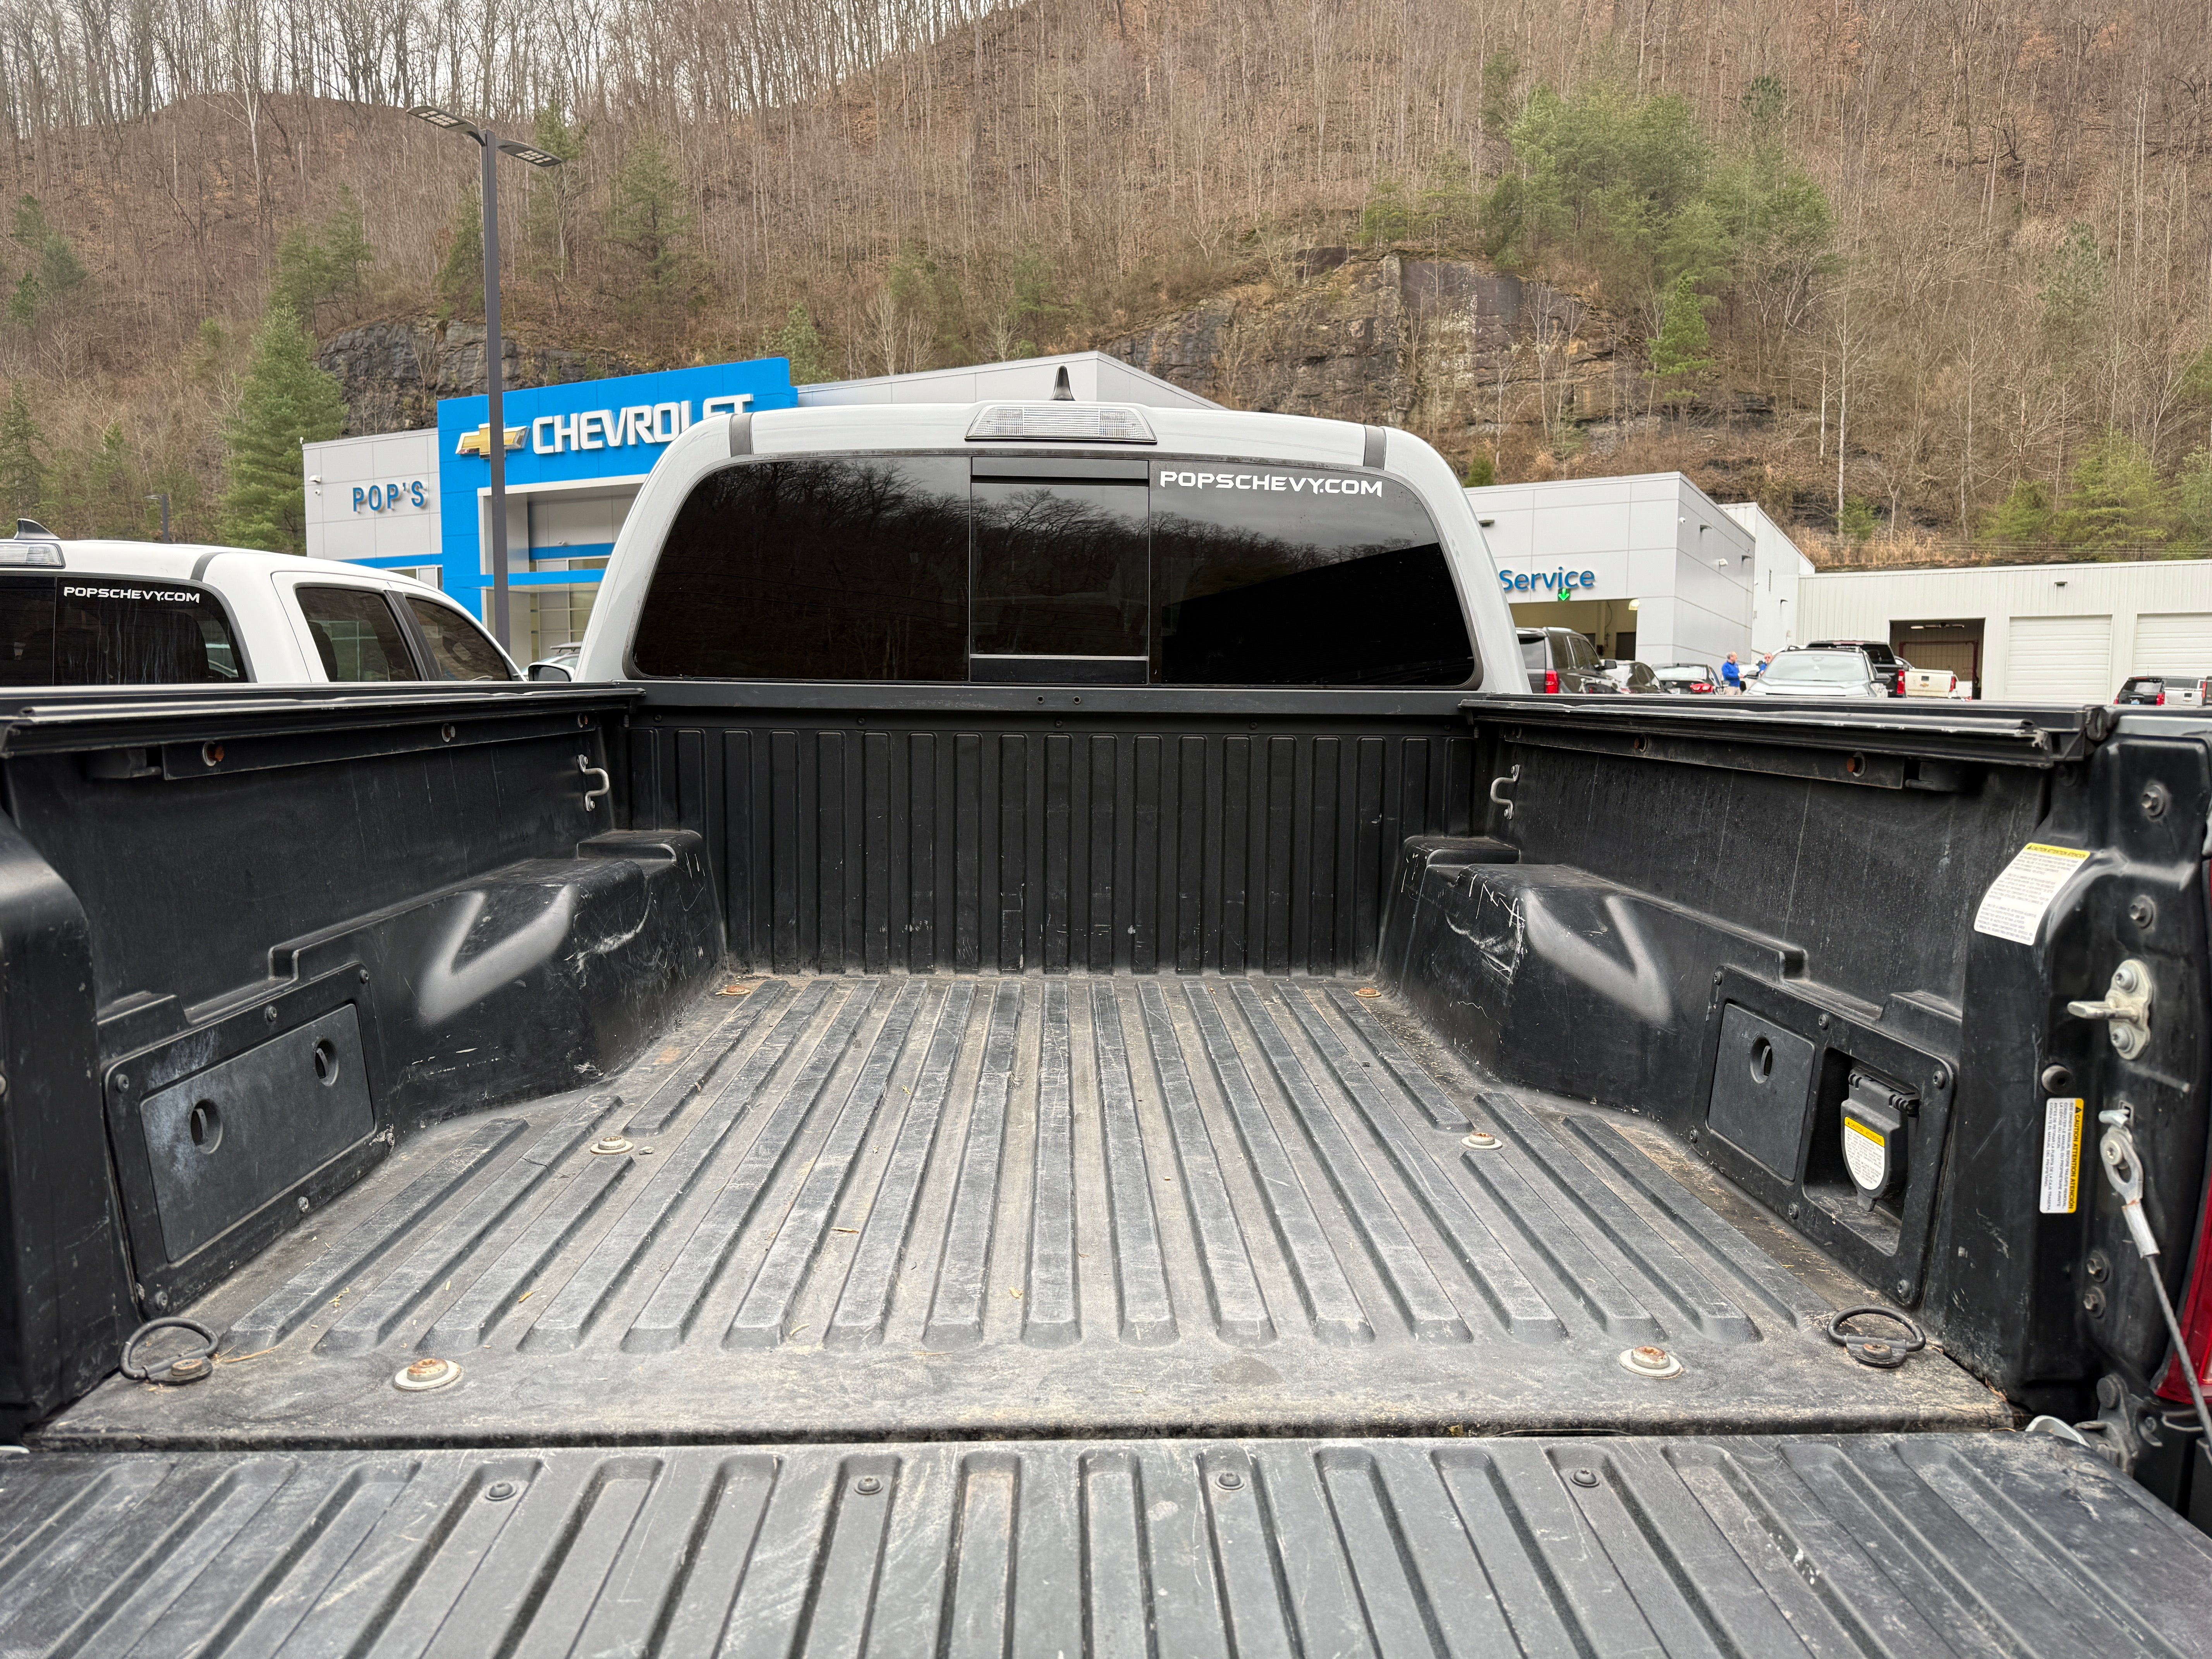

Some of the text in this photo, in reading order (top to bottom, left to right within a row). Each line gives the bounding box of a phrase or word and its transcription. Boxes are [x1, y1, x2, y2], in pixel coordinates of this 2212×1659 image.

[352, 481, 424, 512] POP'S
[1160, 471, 1382, 498] POPSCHEVY.COM
[1499, 567, 1595, 591] Service
[64, 587, 200, 603] POPSCHEVY.COM
